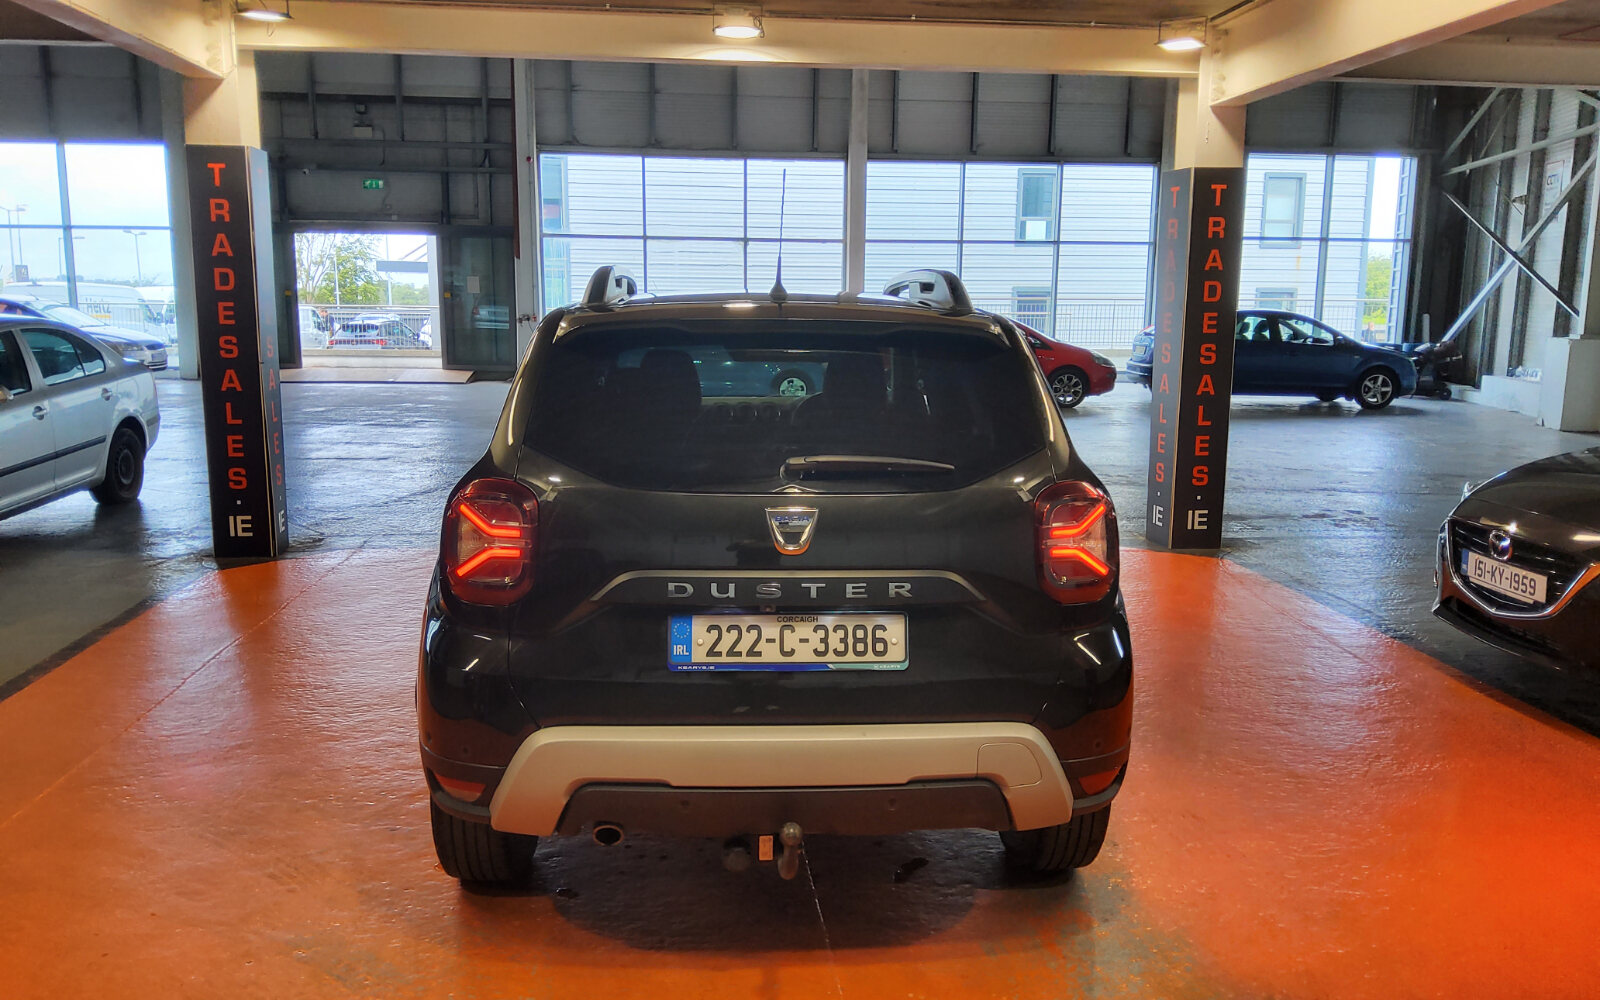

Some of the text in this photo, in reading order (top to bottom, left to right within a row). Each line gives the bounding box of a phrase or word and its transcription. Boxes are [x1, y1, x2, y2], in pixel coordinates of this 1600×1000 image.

[1474, 558, 1537, 597] 151-KY-1959
[667, 582, 912, 598] DUSTER
[776, 615, 819, 623] CORCAIGH
[705, 624, 888, 658] 222-C-3386
[673, 645, 689, 656] IRL
